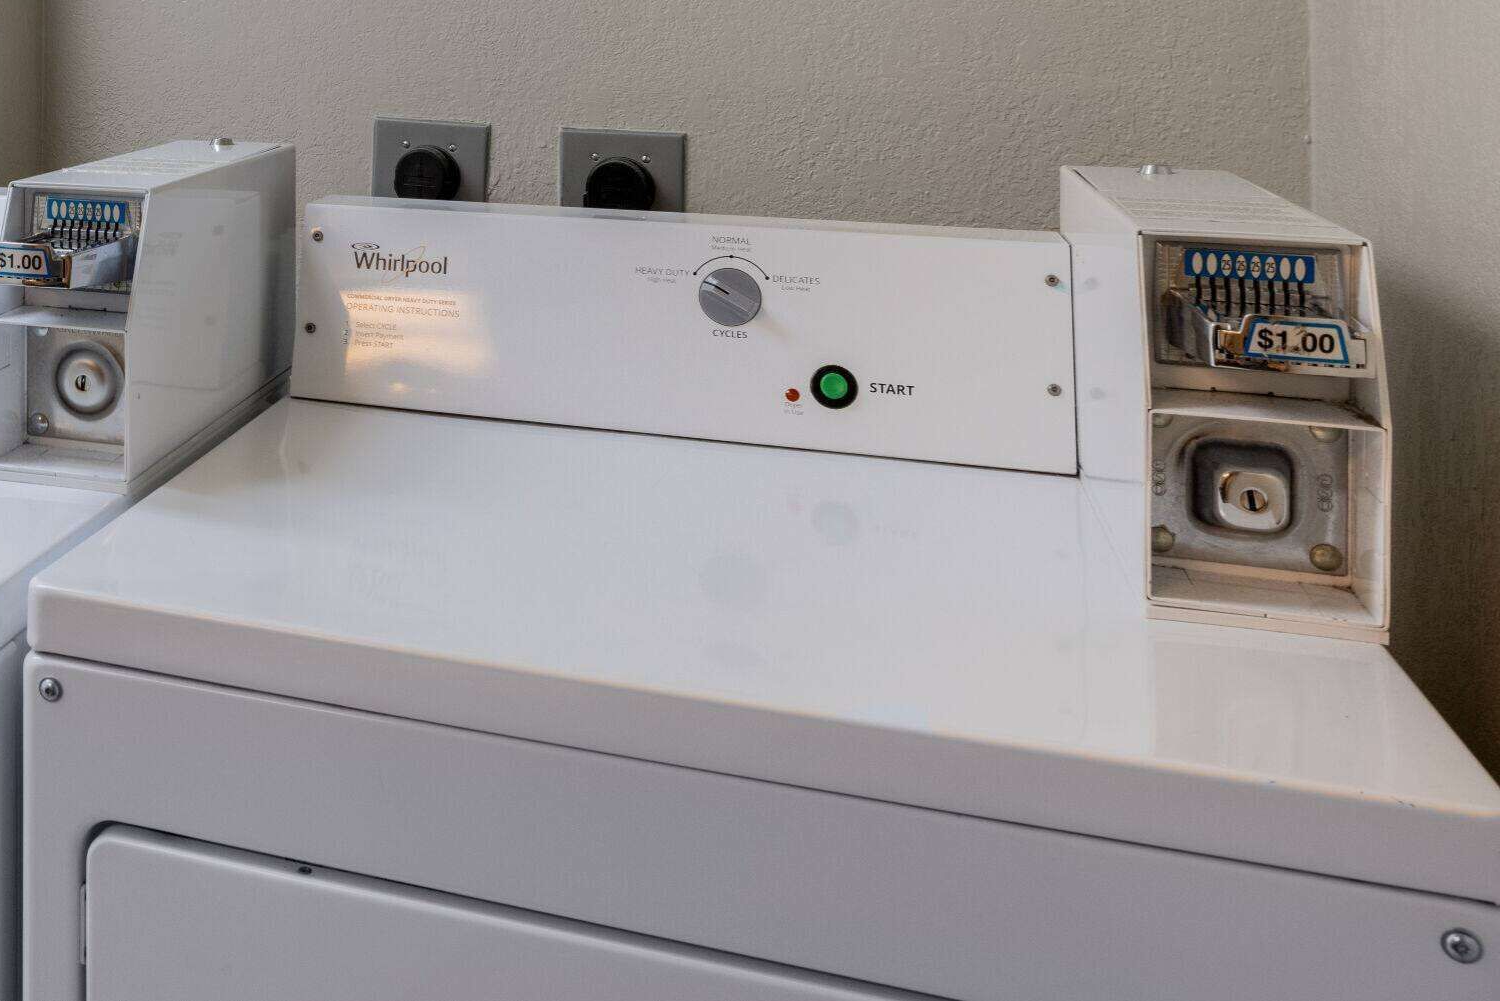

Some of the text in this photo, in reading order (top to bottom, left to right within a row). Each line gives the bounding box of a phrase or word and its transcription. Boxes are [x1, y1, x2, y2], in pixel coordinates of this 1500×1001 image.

[354, 251, 448, 277] Whirlpool
[1222, 259, 1275, 273] 25 25 25 25
[347, 302, 460, 318] OPERATING INSTRUCTIONS
[712, 329, 748, 339] CYCLES
[870, 382, 915, 396] START
